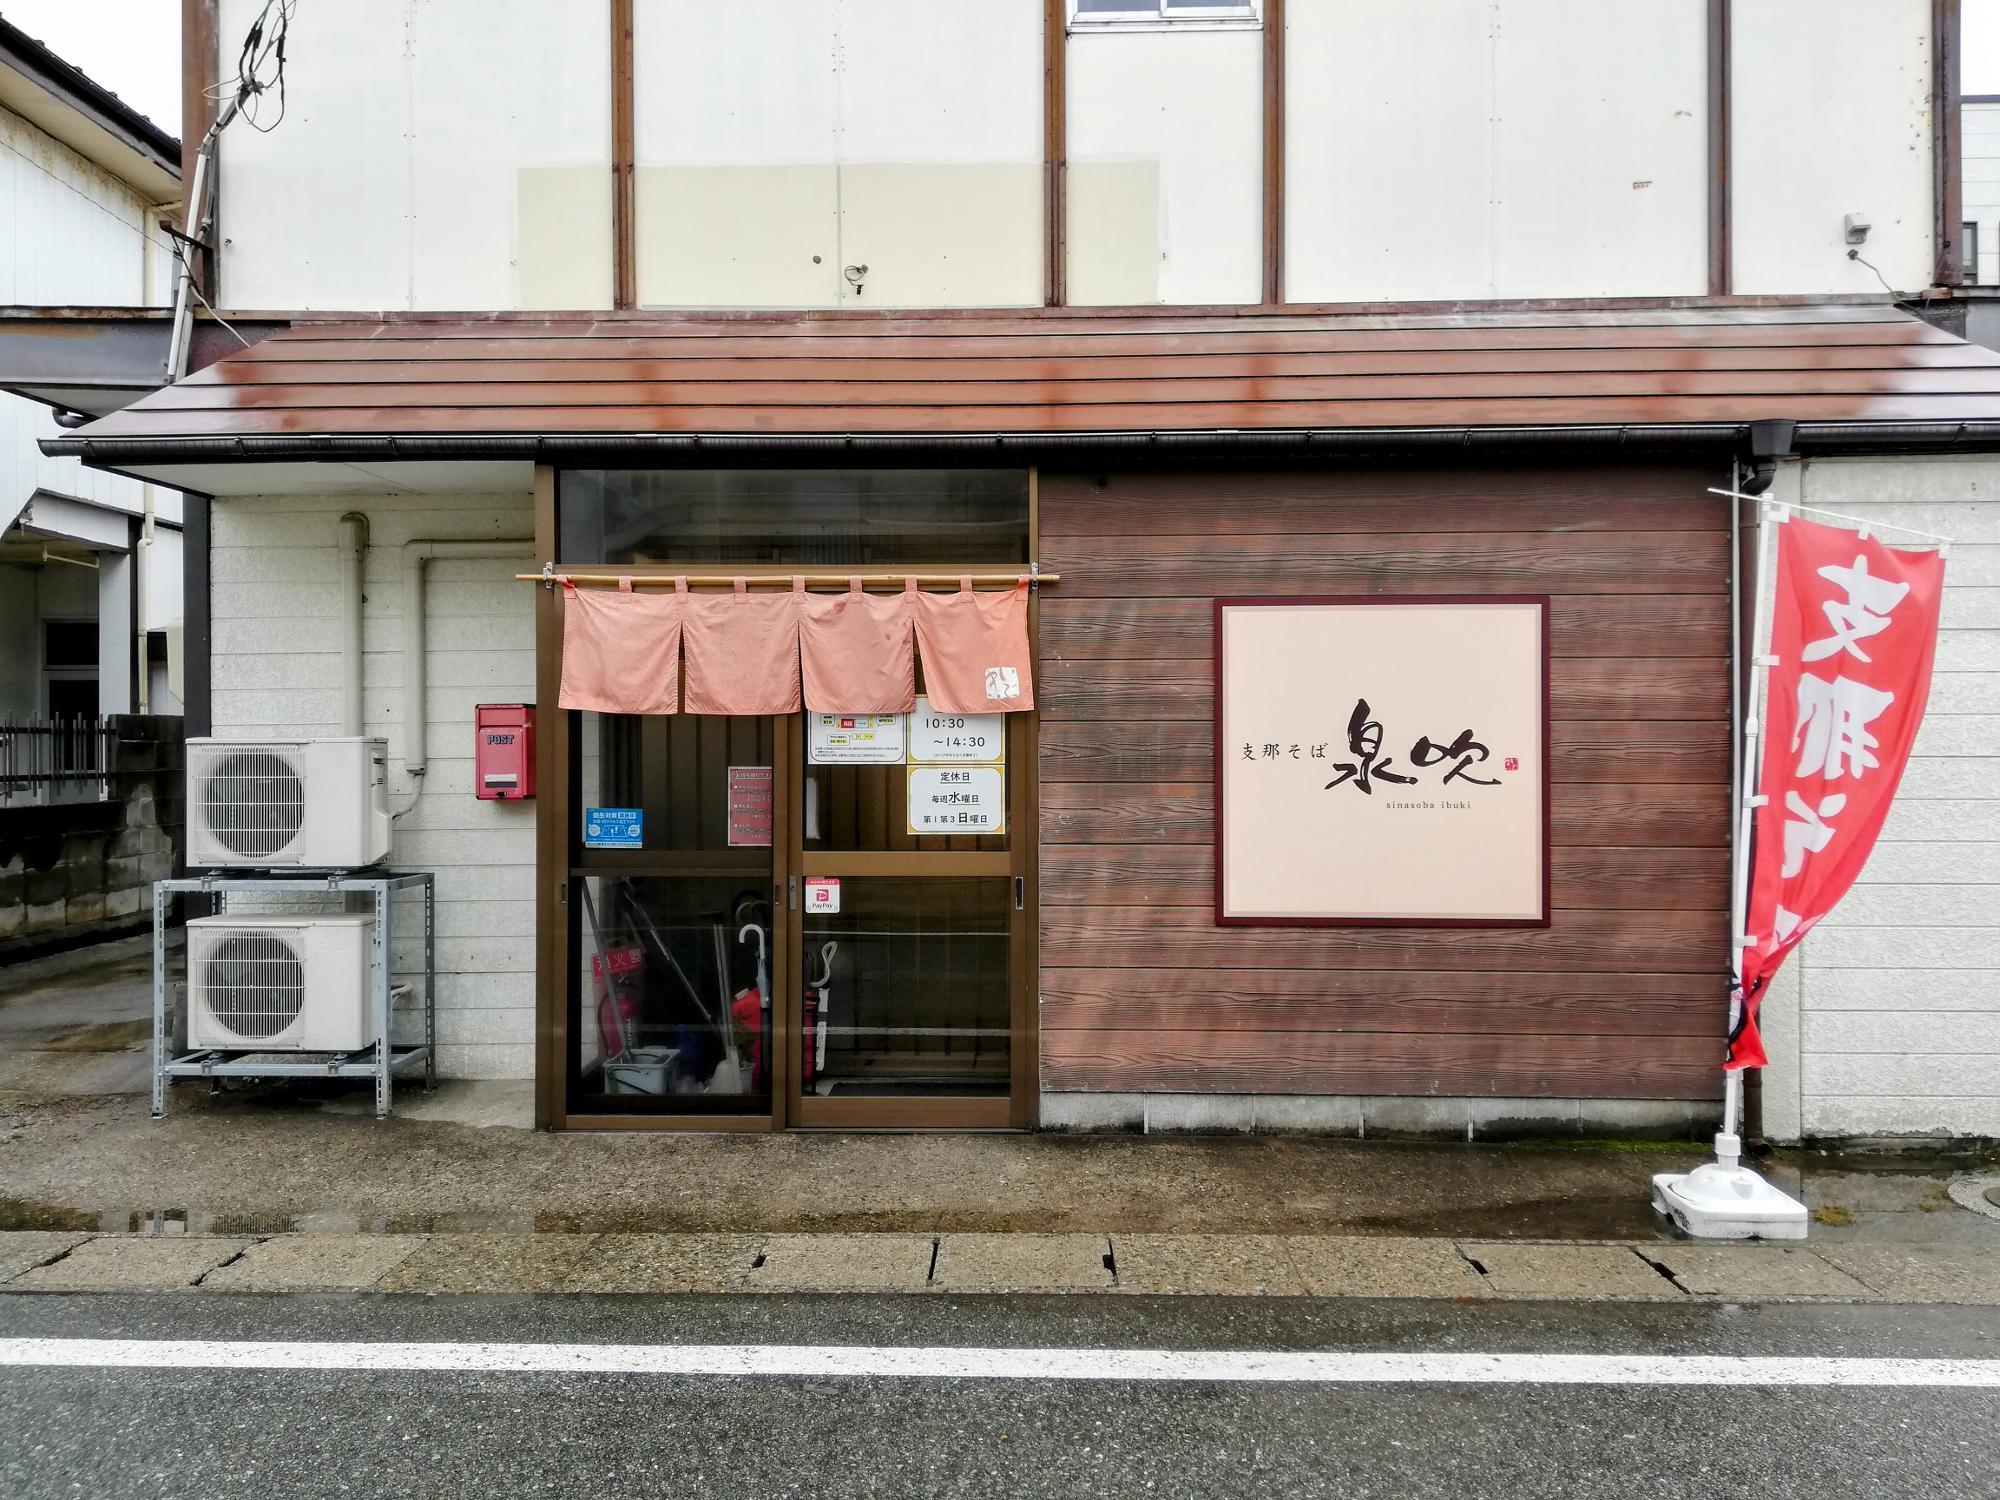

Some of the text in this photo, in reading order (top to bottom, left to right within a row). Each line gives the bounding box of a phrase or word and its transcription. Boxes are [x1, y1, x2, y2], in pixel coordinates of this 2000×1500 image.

[925, 718, 965, 729] 10:30
[487, 735, 514, 745] POST
[1240, 698, 1502, 795] 支那そば 泉吹
[940, 772, 970, 782] 定休日
[932, 791, 979, 804] 毎週水曜日
[1386, 800, 1471, 809] sinasoba ibuki
